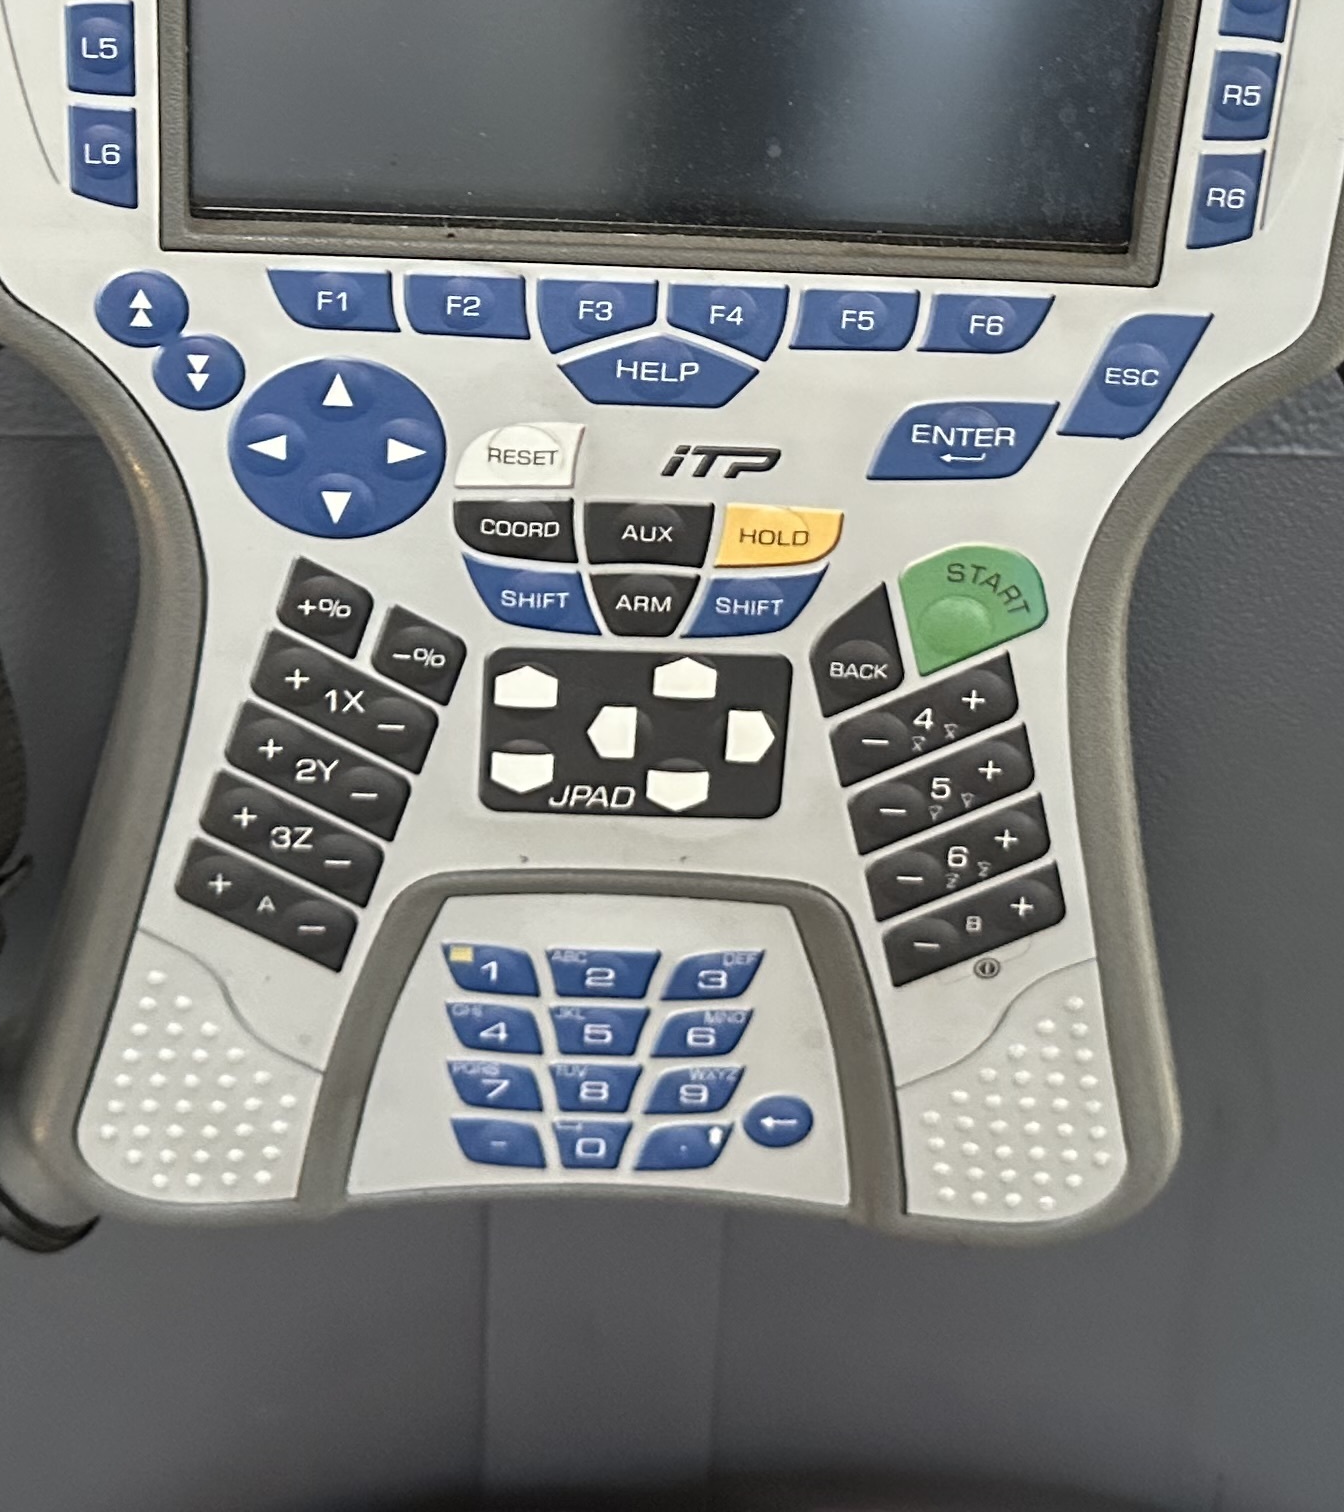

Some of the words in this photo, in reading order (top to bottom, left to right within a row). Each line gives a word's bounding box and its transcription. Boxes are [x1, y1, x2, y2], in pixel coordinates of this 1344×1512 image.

[81, 37, 118, 60] L5
[1222, 85, 1261, 107] R5
[84, 143, 121, 165] L6
[1205, 187, 1246, 209] R6
[316, 289, 349, 312] F1
[446, 295, 482, 318] F2
[578, 300, 613, 322] F3
[709, 305, 744, 326] F4
[841, 309, 875, 331] F5
[969, 315, 1005, 337] F6
[615, 358, 700, 383] HELP
[1104, 367, 1159, 387] ESC
[911, 422, 1016, 448] ENTER
[487, 447, 558, 467] RESET
[480, 518, 561, 538] COORD
[621, 524, 674, 543] AUX
[739, 527, 810, 548] HOLD
[946, 562, 1031, 616] START
[500, 590, 570, 610] SHIFT
[615, 594, 672, 613] ARM
[715, 597, 784, 617] SHIFT
[829, 661, 889, 680] BACK
[323, 689, 366, 714] 1X
[912, 707, 934, 730] 4
[294, 758, 339, 782] 2Y
[548, 785, 636, 809] JPAD
[930, 777, 951, 799] 5
[270, 826, 314, 852] 3Z
[947, 845, 969, 868] 6
[256, 895, 276, 912] A
[480, 961, 498, 982] 1
[584, 967, 616, 987] 2
[697, 969, 728, 989] 3
[479, 1021, 508, 1041] 4
[583, 1023, 613, 1045] 5
[686, 1026, 716, 1047] 6
[481, 1078, 510, 1099] 7
[579, 1081, 609, 1101] 8
[679, 1084, 708, 1104] 9
[575, 1137, 606, 1158] 0
